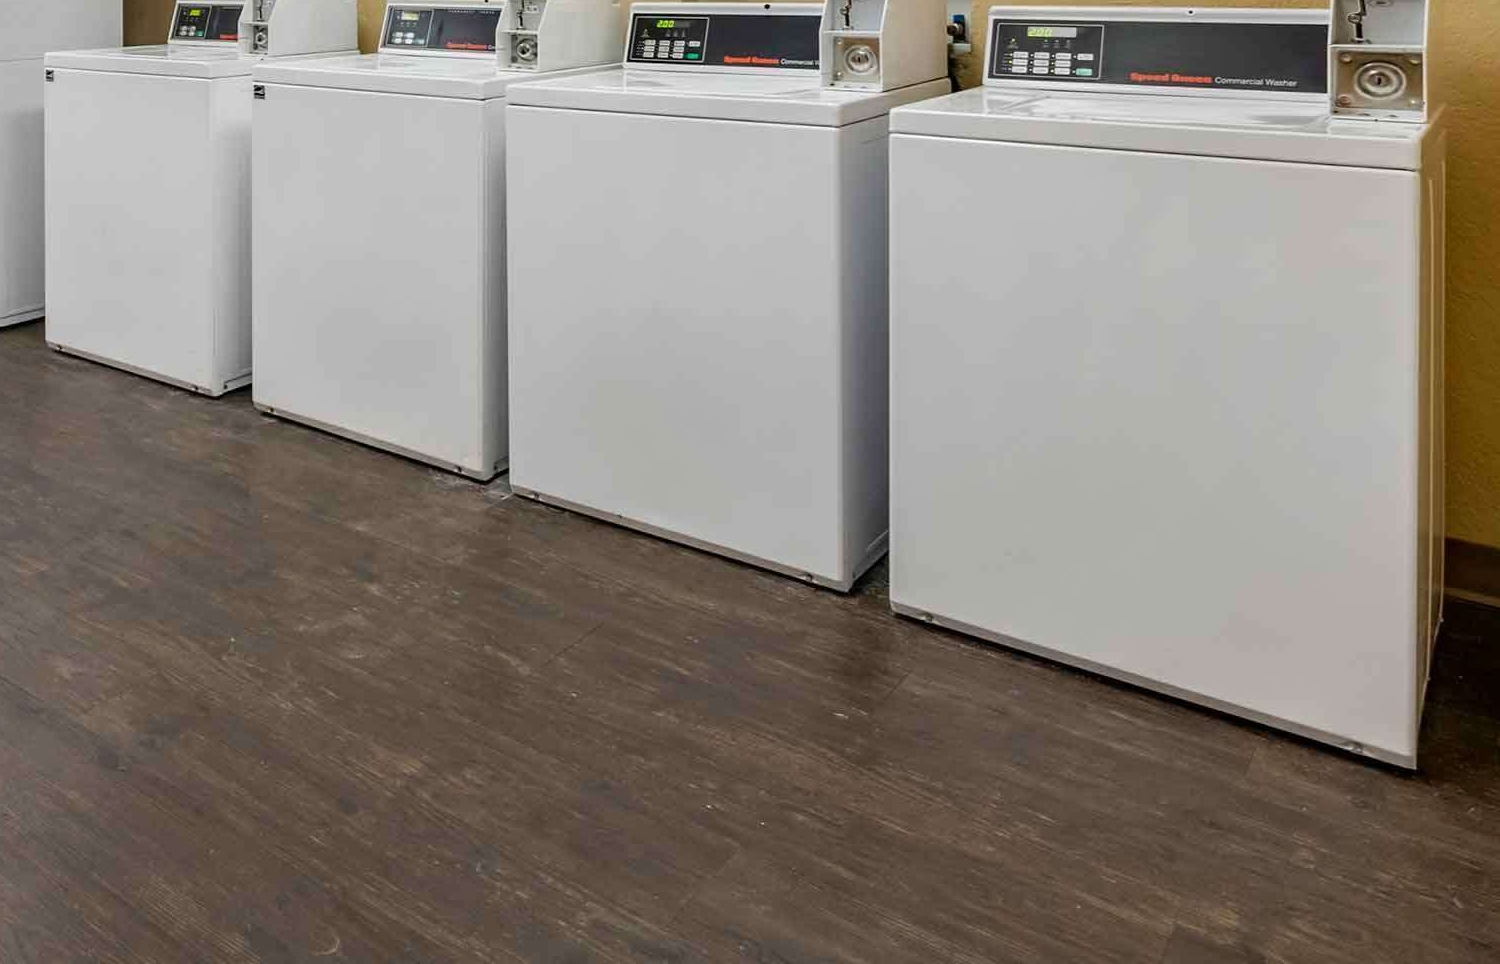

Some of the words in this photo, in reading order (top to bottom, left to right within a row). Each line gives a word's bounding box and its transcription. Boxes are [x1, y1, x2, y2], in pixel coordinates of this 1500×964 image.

[1129, 72, 1169, 83] Speed
[1214, 76, 1264, 86] Commercial
[1265, 78, 1298, 88] Washer
